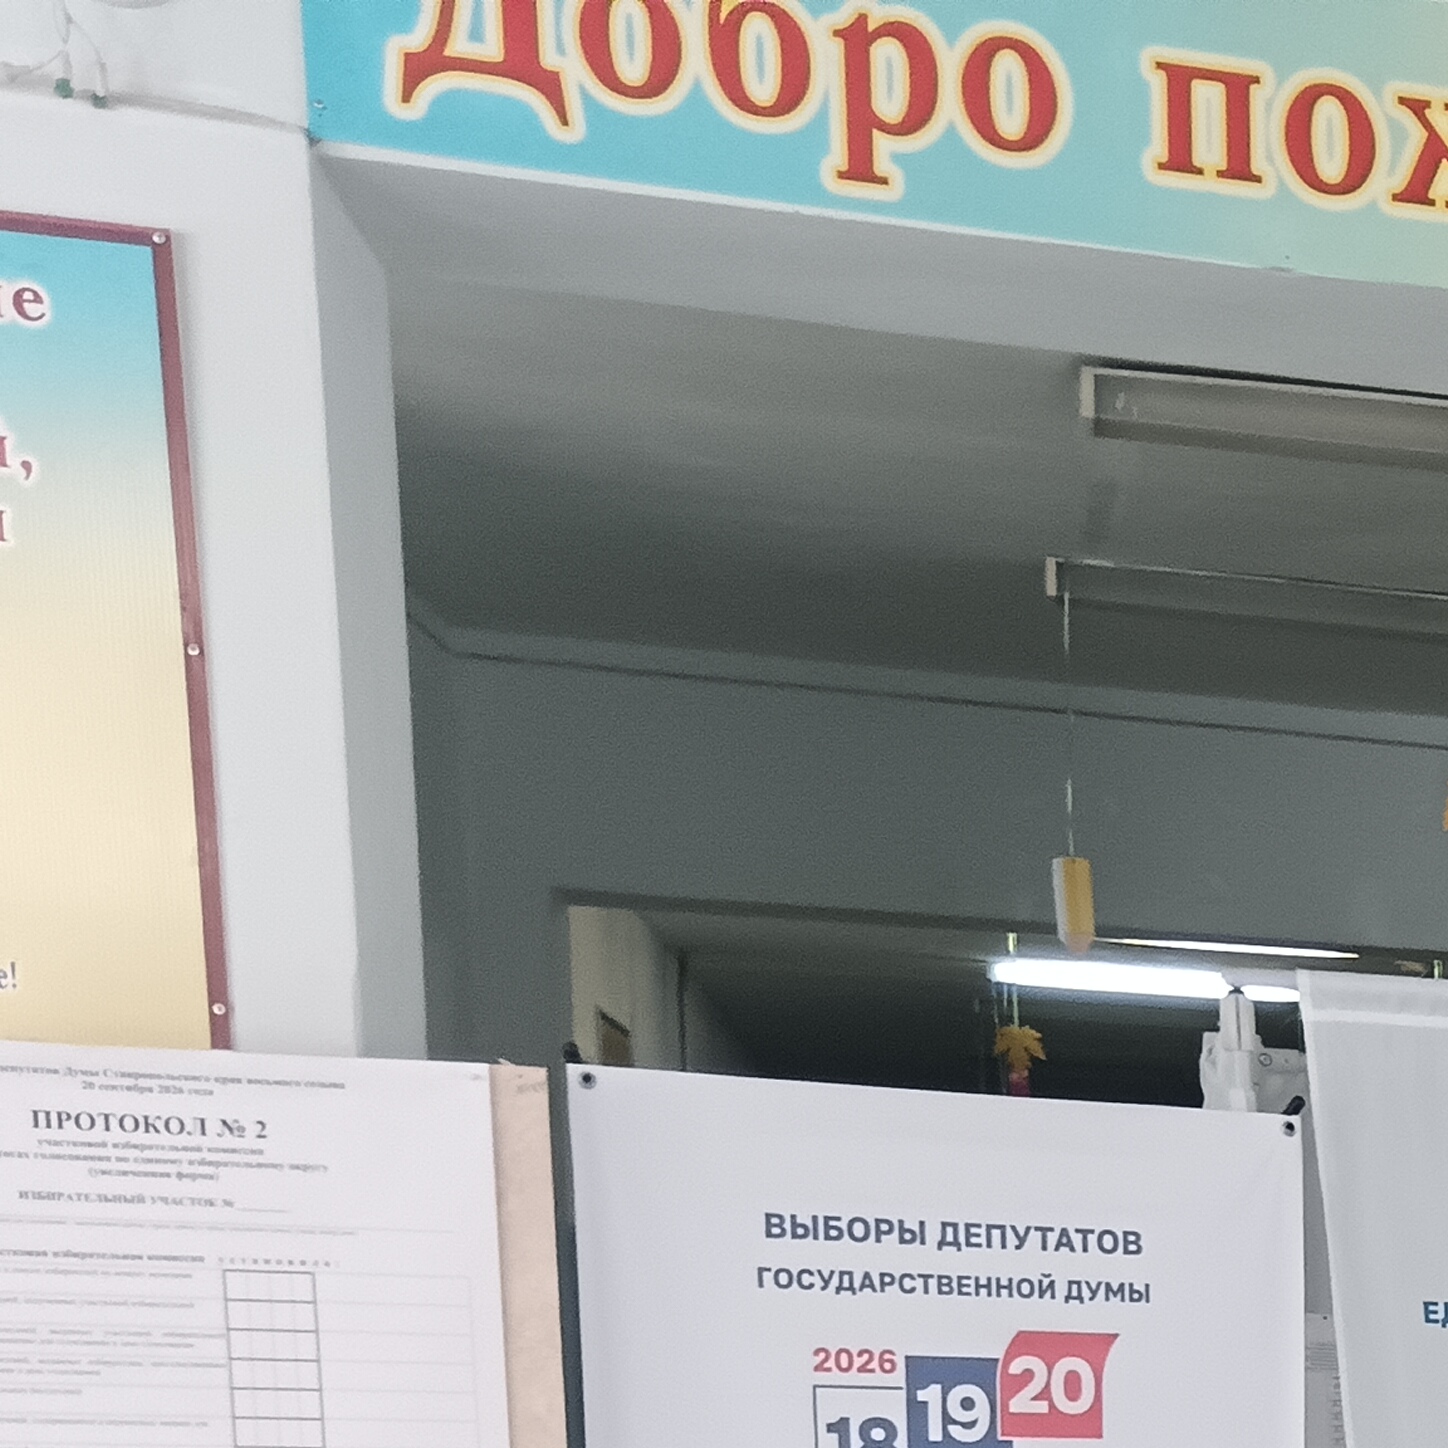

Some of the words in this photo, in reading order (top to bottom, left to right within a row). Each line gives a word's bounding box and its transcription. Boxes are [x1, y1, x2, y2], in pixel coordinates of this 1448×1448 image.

[30, 1109, 209, 1138] ПРОТОКОЛ
[216, 1117, 247, 1139] №
[255, 1120, 269, 1140] 2
[763, 1211, 928, 1247] ВЫБОРЫ
[936, 1221, 1144, 1258] ДЕПУТАТОВ
[755, 1265, 1058, 1302] ГОСУДАРСТВЕННОЙ
[1064, 1279, 1152, 1305] ДУМЫ
[812, 1347, 898, 1375] 2026
[915, 1383, 991, 1444] 19
[1008, 1355, 1096, 1416] 20
